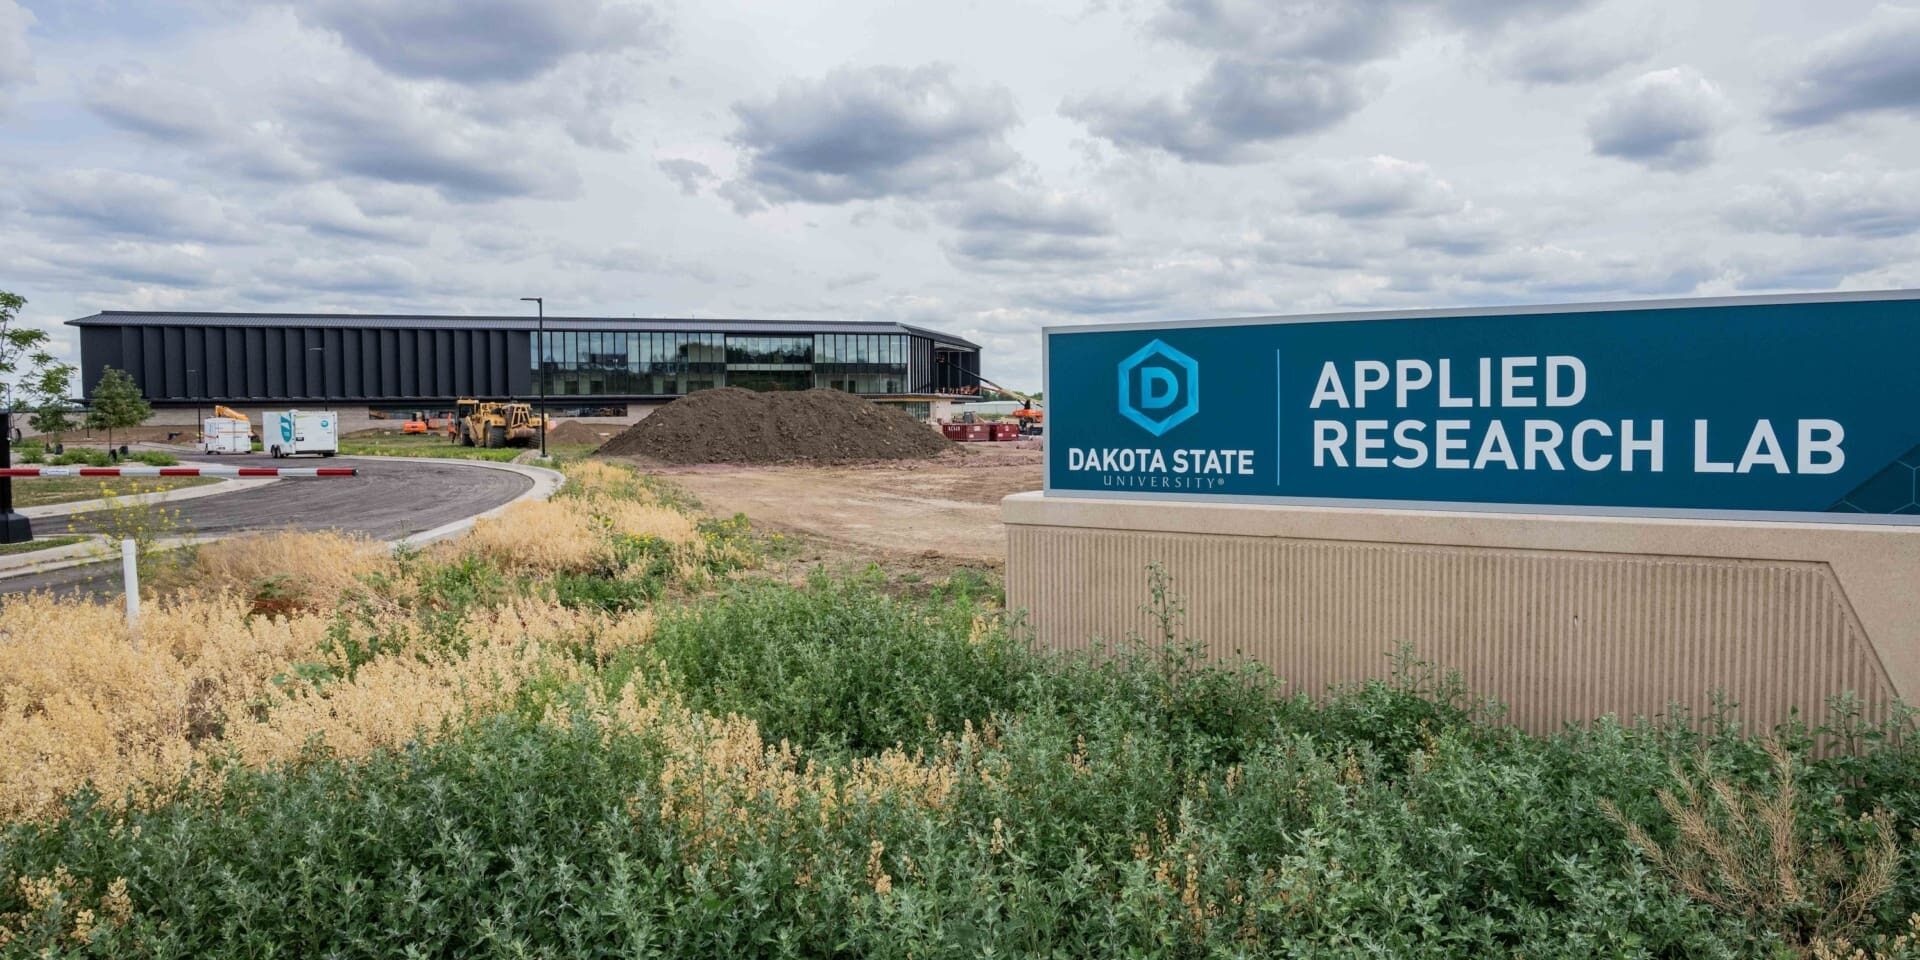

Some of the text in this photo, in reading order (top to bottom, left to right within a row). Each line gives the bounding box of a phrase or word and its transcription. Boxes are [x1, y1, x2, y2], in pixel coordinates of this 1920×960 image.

[1141, 366, 1179, 409] D
[1310, 355, 1587, 409] APPLIED
[1069, 447, 1254, 475] DAKOTA STATE
[1313, 418, 1845, 475] RESEARCH LAB
[1104, 475, 1215, 488] UNIVERSITY
